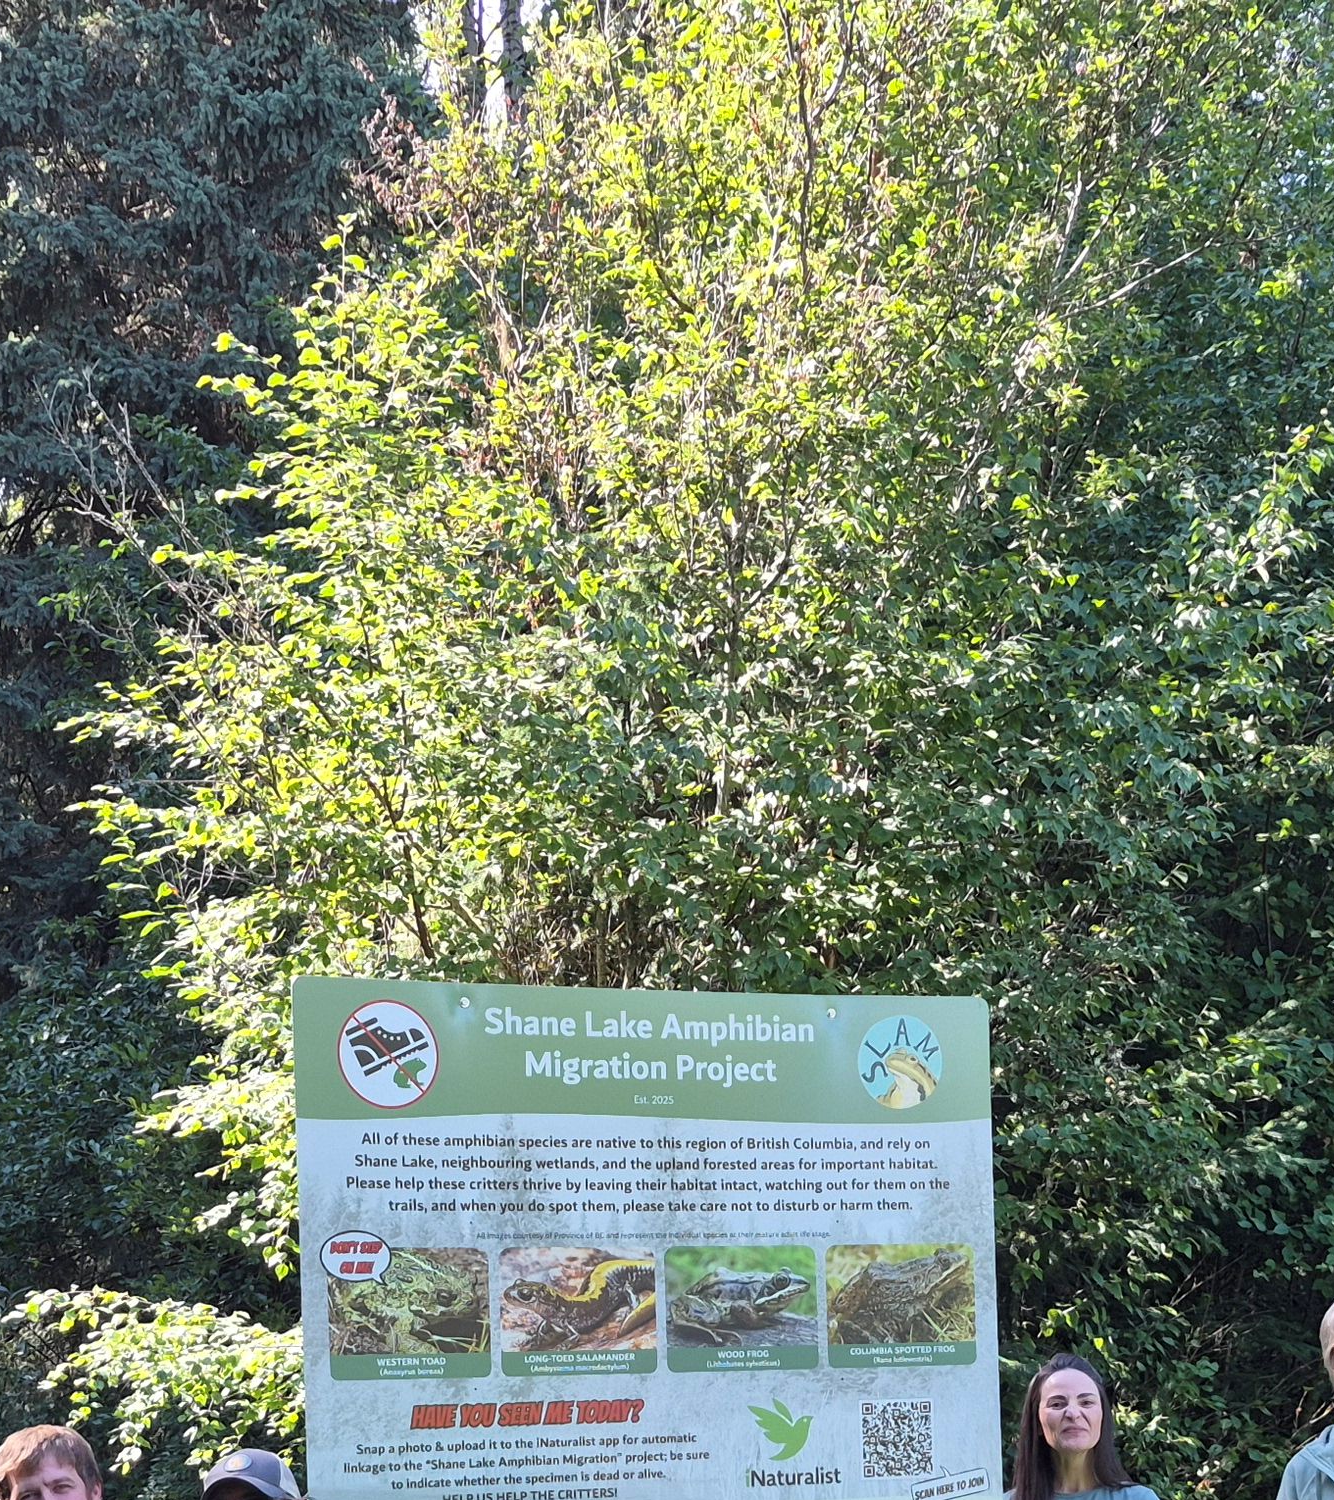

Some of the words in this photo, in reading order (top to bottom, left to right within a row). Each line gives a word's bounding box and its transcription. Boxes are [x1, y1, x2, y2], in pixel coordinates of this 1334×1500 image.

[484, 1006, 576, 1036] Shane
[585, 1010, 653, 1039] Lake
[661, 1013, 815, 1047] Amphibian
[525, 1050, 667, 1085] Migration
[676, 1055, 777, 1088] Project
[633, 1094, 648, 1105] Est.
[651, 1094, 675, 1105] 2025
[361, 1131, 381, 1145] All
[384, 1131, 399, 1145] of
[402, 1132, 440, 1146] these
[443, 1132, 515, 1151] amphibian
[518, 1134, 568, 1152] species
[571, 1138, 593, 1148] are
[596, 1135, 637, 1149] native
[639, 1137, 654, 1149] to
[657, 1135, 682, 1149] this
[685, 1135, 727, 1153] region
[730, 1136, 744, 1149] of
[746, 1136, 790, 1149] British
[793, 1136, 857, 1152] Columbia,
[859, 1136, 884, 1149] and
[887, 1136, 911, 1153] rely
[914, 1140, 931, 1149] on
[354, 1153, 398, 1167] Shane
[401, 1154, 438, 1170] Lake,
[441, 1154, 533, 1173] neighbouring
[535, 1155, 599, 1172] wetlands,
[601, 1156, 627, 1169] and
[630, 1156, 652, 1170] the
[655, 1156, 700, 1174] upland
[702, 1156, 757, 1170] forested
[760, 1160, 796, 1170] areas
[798, 1156, 818, 1170] for
[820, 1156, 886, 1174] important
[888, 1156, 938, 1169] habitat.
[346, 1175, 391, 1189] Please
[394, 1175, 425, 1193] help
[427, 1176, 466, 1190] these
[469, 1176, 519, 1190] critters
[522, 1177, 562, 1190] thrive
[565, 1177, 582, 1194] by
[584, 1177, 633, 1195] leaving
[635, 1177, 668, 1191] their
[670, 1177, 718, 1191] habitat
[720, 1177, 762, 1193] intact,
[764, 1177, 823, 1194] watching
[826, 1178, 848, 1190] out
[851, 1176, 870, 1190] for
[873, 1176, 906, 1190] them
[909, 1180, 926, 1190] on
[928, 1176, 950, 1189] the
[388, 1198, 428, 1214] trails,
[431, 1198, 457, 1212] and
[459, 1198, 496, 1212] when
[499, 1202, 524, 1216] you
[527, 1198, 545, 1212] do
[548, 1200, 578, 1216] spot
[581, 1198, 620, 1214] them,
[622, 1198, 665, 1216] please
[667, 1198, 697, 1211] take
[699, 1202, 728, 1211] care
[731, 1199, 753, 1211] not
[755, 1199, 770, 1211] to
[773, 1197, 820, 1211] disturb
[822, 1201, 837, 1211] or
[840, 1197, 874, 1211] harm
[876, 1197, 913, 1211] them.
[524, 1353, 575, 1363] LONG-TOED
[576, 1352, 636, 1362] SALAMANDER
[718, 1350, 745, 1359] WOOD
[747, 1350, 769, 1358] FROG
[850, 1346, 893, 1356] COLUMBIA
[894, 1345, 932, 1355] SPOTTED
[933, 1345, 956, 1353] FROG
[377, 1357, 419, 1367] WESTERN
[421, 1357, 447, 1366] TOAD
[410, 1405, 458, 1429] HAVE
[460, 1403, 496, 1428] YOU
[498, 1401, 543, 1426] SEEN
[543, 1401, 575, 1425] ME
[577, 1399, 645, 1424] TODAY?
[356, 1442, 386, 1458] Snap
[388, 1445, 395, 1454] a
[398, 1440, 433, 1456] photo
[435, 1440, 445, 1452] &
[447, 1438, 486, 1454] upload
[489, 1438, 498, 1449] it
[500, 1438, 512, 1449] to
[514, 1436, 534, 1449] the
[536, 1434, 596, 1448] iNaturalist
[598, 1437, 620, 1449] app
[622, 1433, 639, 1445] for
[641, 1431, 697, 1444] automatic
[343, 1460, 386, 1476] linkage
[388, 1461, 401, 1471] to
[403, 1459, 423, 1471] the
[468, 1456, 496, 1468] Lake
[498, 1453, 560, 1470] Amphibian
[625, 1449, 668, 1465] project;
[669, 1449, 684, 1461] be
[685, 1451, 710, 1460] sure
[390, 1478, 404, 1489] to
[405, 1475, 452, 1488] indicate
[453, 1473, 501, 1486] whether
[503, 1472, 523, 1484] the
[524, 1470, 579, 1487] specimen
[580, 1470, 591, 1481] is
[592, 1468, 620, 1481] dead
[622, 1471, 636, 1480] or
[637, 1467, 667, 1479] alive.
[745, 1465, 842, 1487] iNaturalist
[530, 1490, 555, 1500] THE
[557, 1487, 618, 1500] CRITTERS!
[914, 1486, 934, 1500] SCAN
[936, 1482, 955, 1496] HERE
[956, 1480, 967, 1492] TO
[968, 1476, 985, 1490] JOIN
